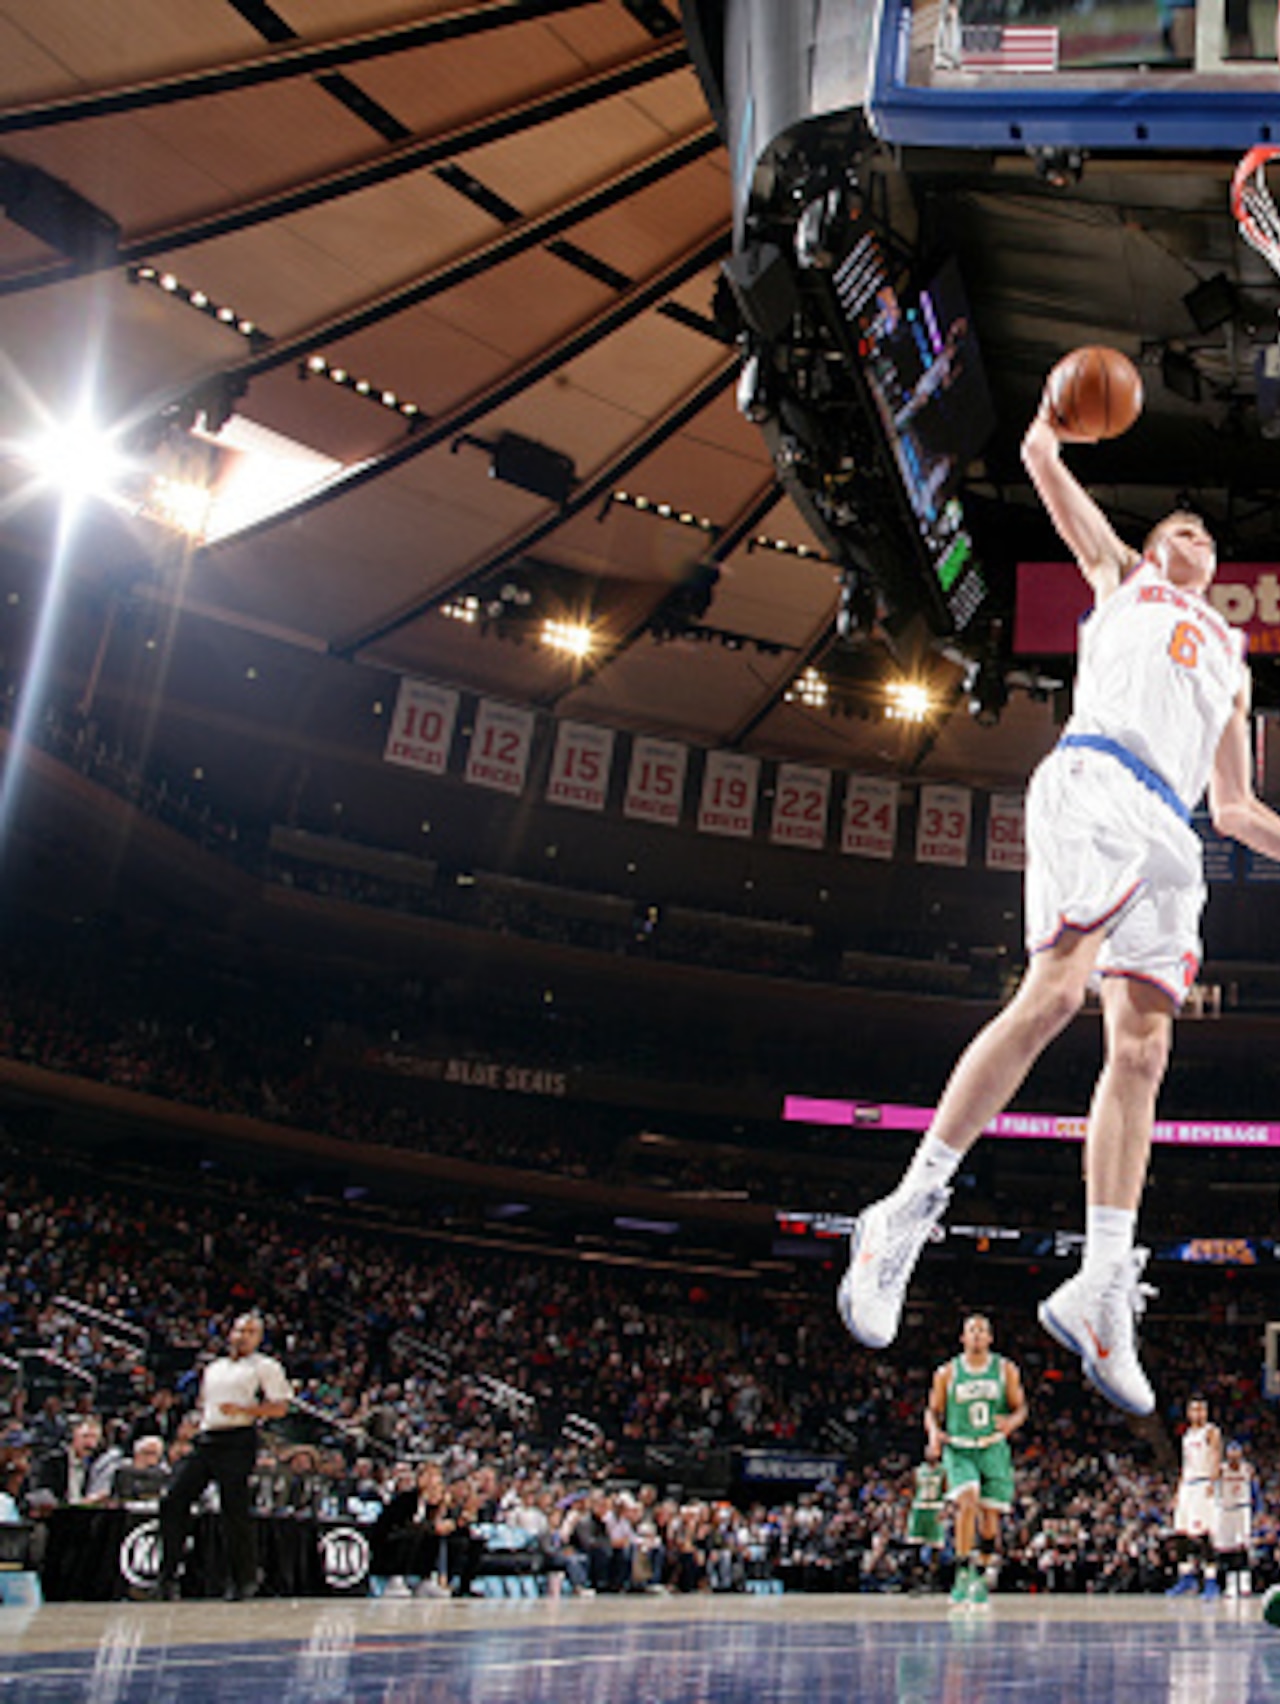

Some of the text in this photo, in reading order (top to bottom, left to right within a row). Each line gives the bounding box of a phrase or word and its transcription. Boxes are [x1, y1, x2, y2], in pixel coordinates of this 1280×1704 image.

[1168, 621, 1205, 668] 6
[402, 704, 444, 743] 10
[480, 726, 521, 765] 12
[562, 746, 602, 782] 15
[637, 762, 677, 796] 15
[711, 776, 748, 809] 19
[780, 787, 823, 821] 22
[850, 797, 892, 833] 24
[925, 808, 966, 840] 33
